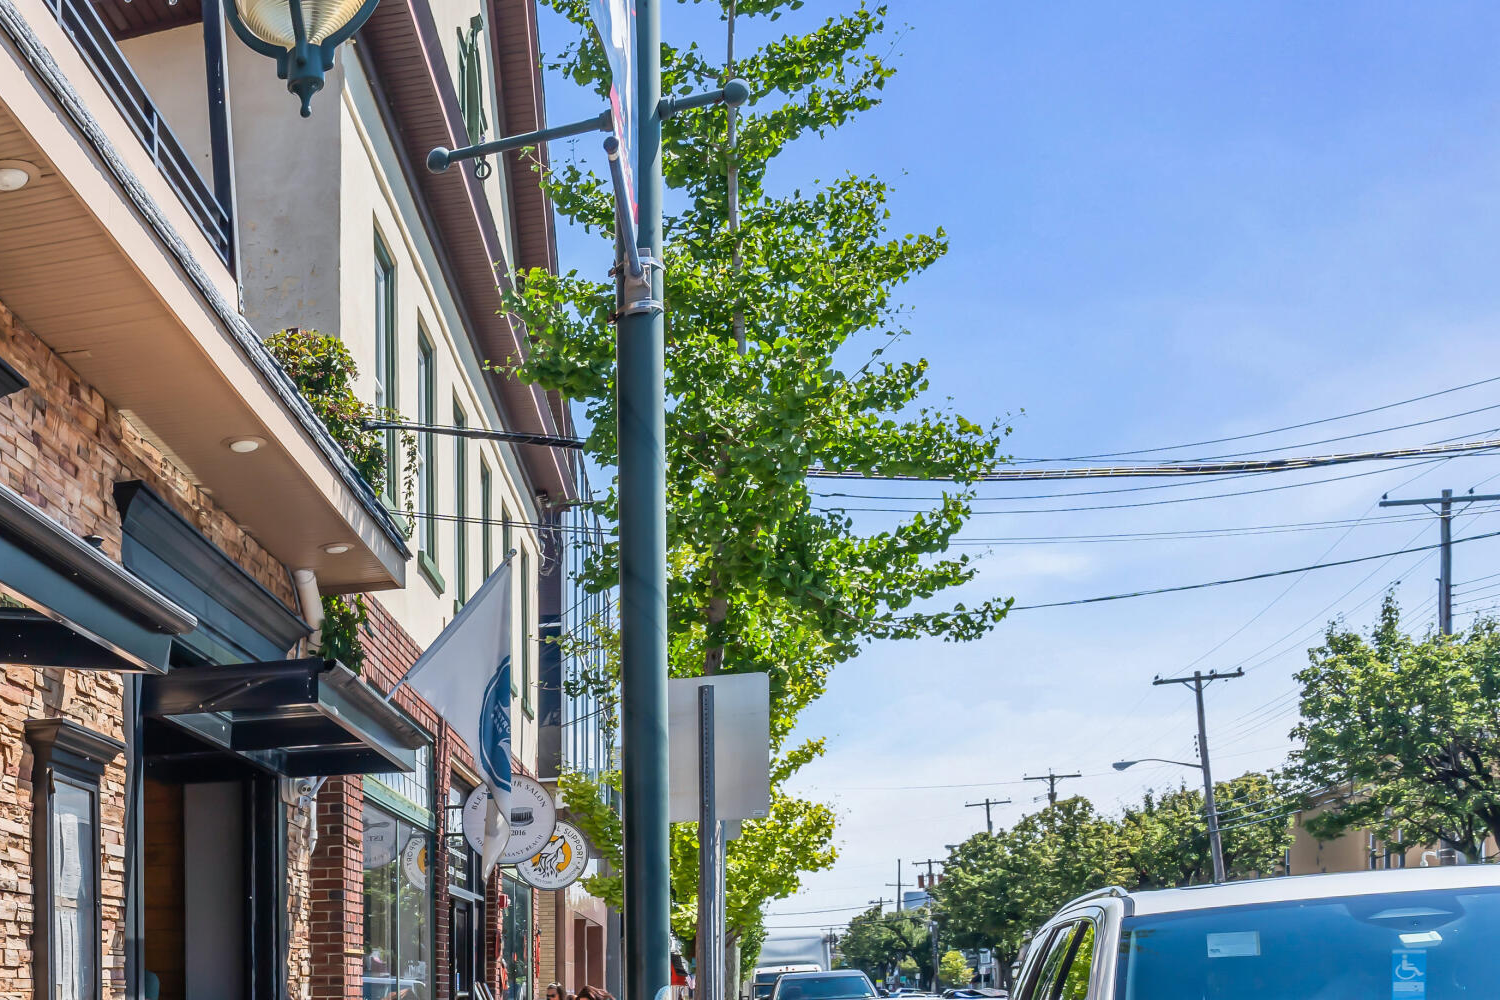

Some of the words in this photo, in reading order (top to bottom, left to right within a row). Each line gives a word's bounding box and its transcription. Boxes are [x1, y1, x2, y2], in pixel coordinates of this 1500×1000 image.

[472, 786, 491, 810] BLEAC
[525, 784, 547, 808] SALON
[525, 834, 544, 852] BEACH
[563, 827, 584, 860] SUPPORT
